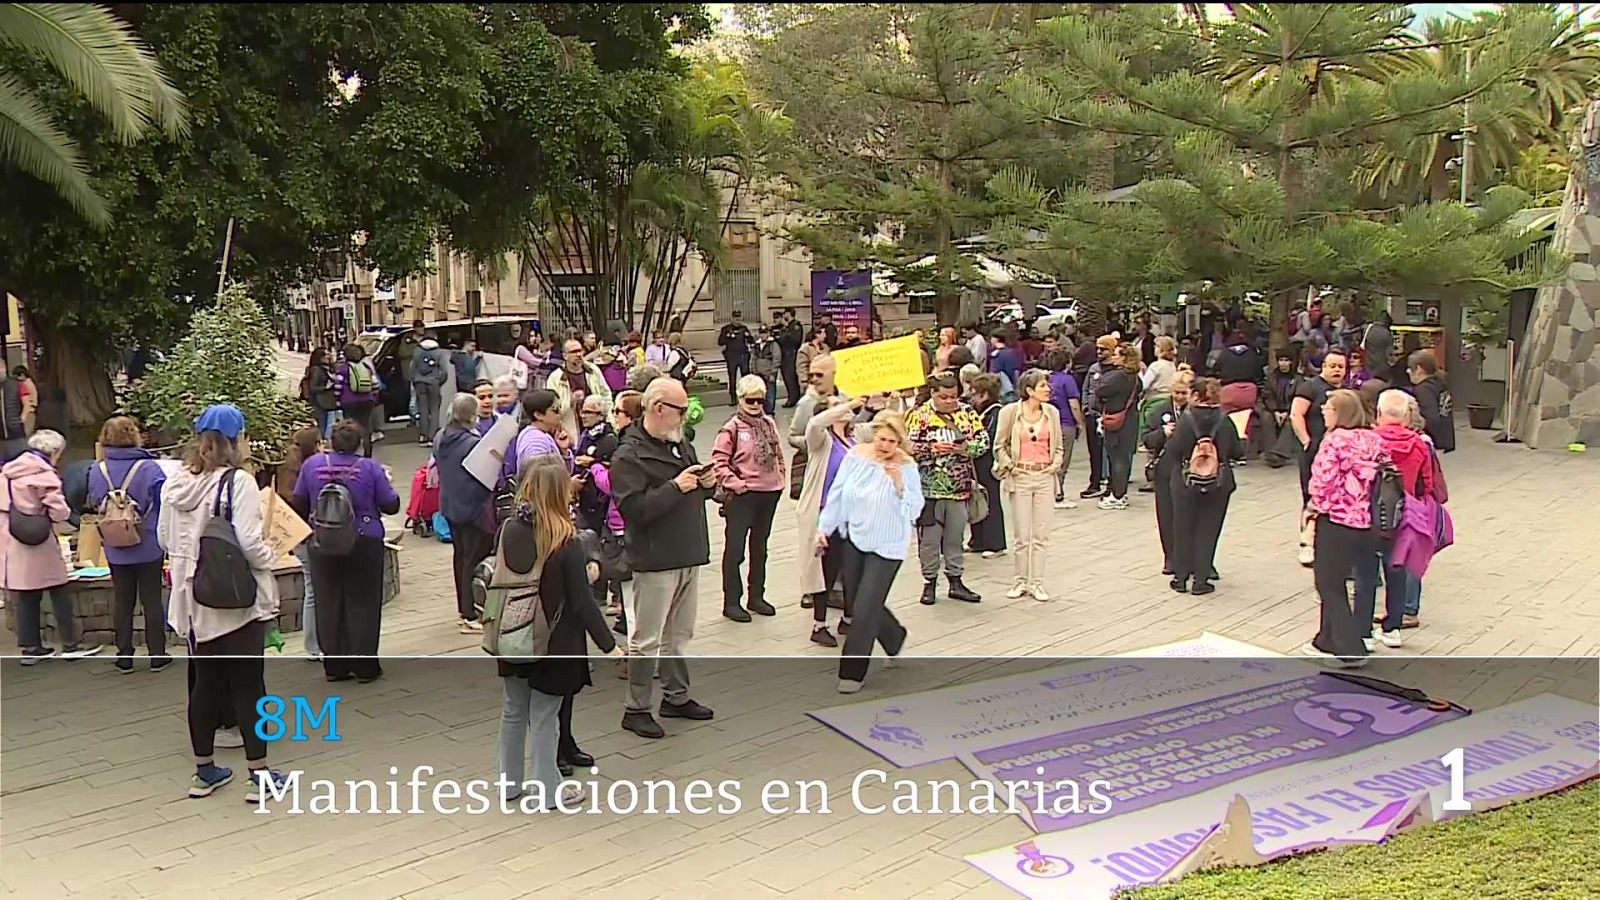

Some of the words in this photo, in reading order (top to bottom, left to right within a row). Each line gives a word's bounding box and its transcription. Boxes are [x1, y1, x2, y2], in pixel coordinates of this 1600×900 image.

[1135, 709, 1227, 736] CONTRA
[1093, 731, 1141, 748] LAS
[1191, 734, 1253, 753] UNA
[1083, 739, 1188, 767] OPRIMA
[1139, 747, 1197, 767] PAZ
[1172, 747, 1294, 783] GUERRAS
[1109, 779, 1173, 801] QUE
[1304, 788, 1379, 812] EL
